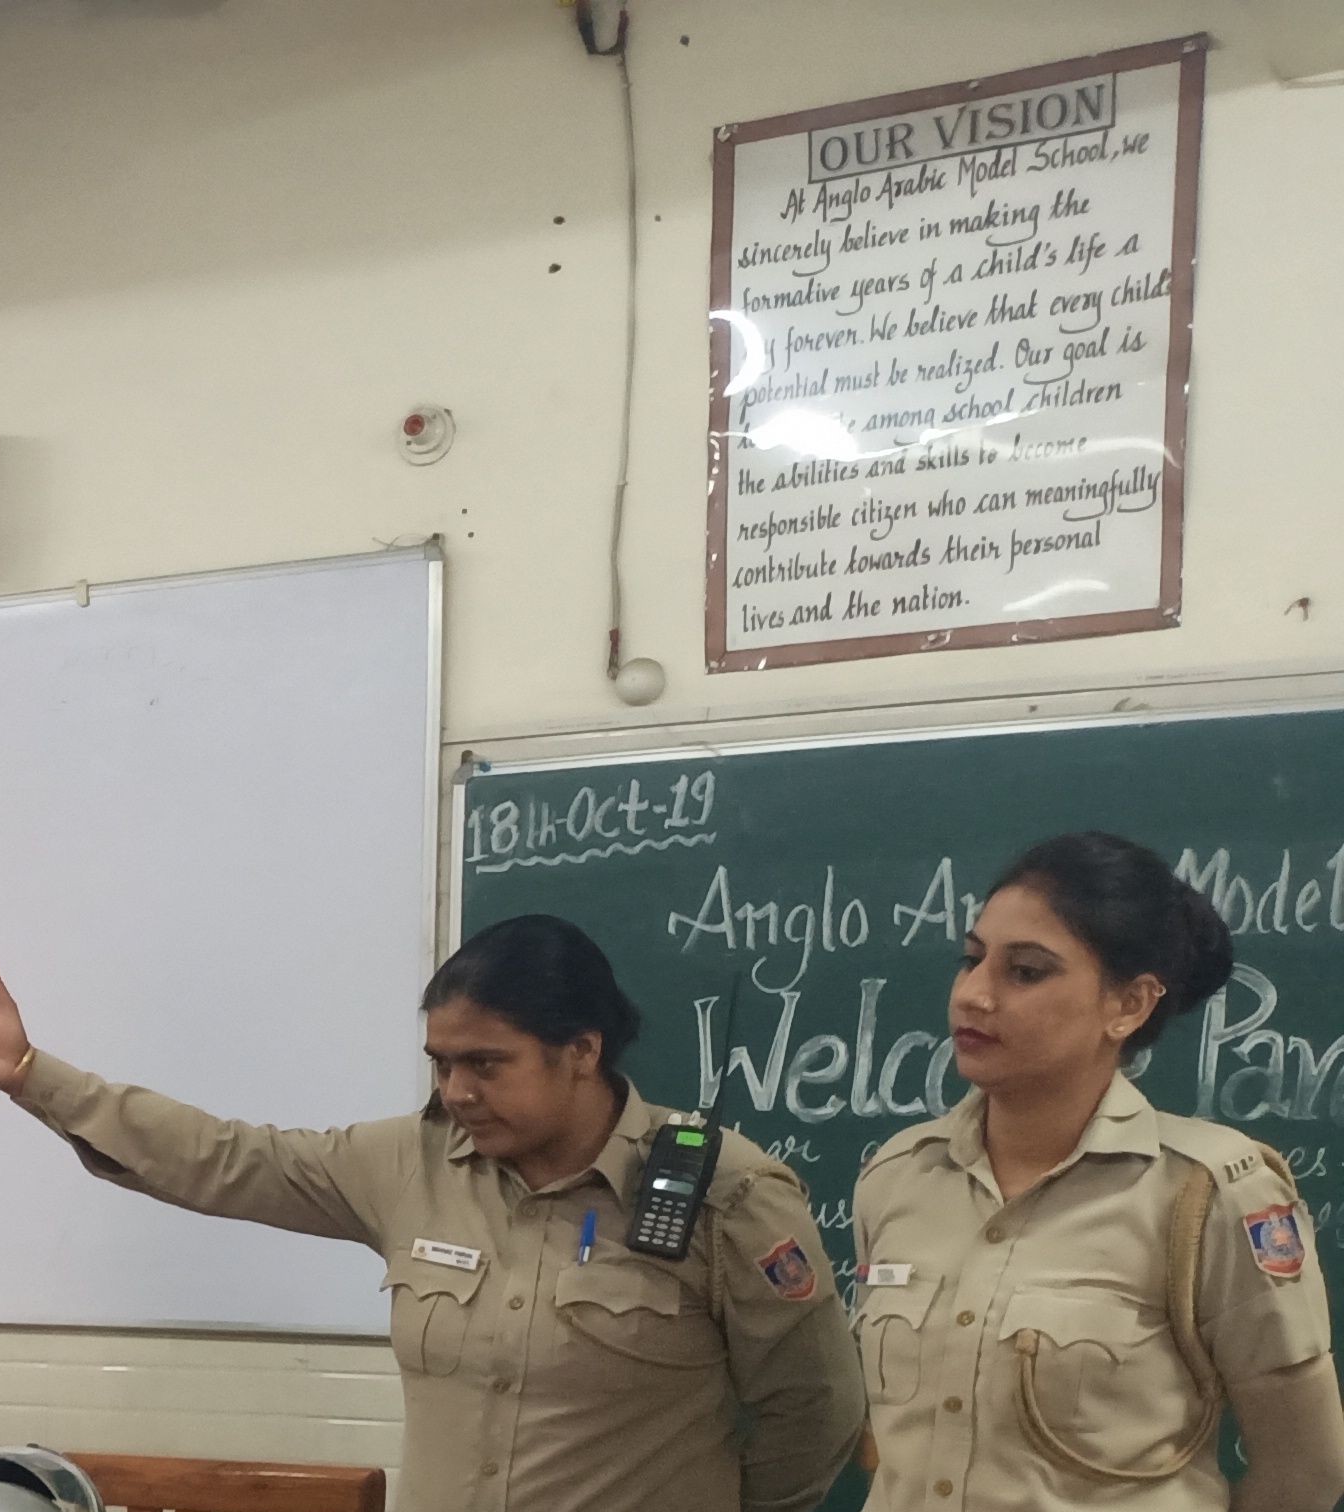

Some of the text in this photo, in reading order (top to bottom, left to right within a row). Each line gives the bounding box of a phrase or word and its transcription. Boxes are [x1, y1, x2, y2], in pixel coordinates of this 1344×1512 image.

[820, 83, 1107, 172] OUR VISION
[780, 129, 1150, 224] At Anglo Arabic Model School, we
[737, 187, 1091, 277] sincerely believe in making the
[740, 232, 1140, 317] formative years of a child's life a
[784, 326, 865, 373] forever.
[869, 311, 898, 343] We
[902, 304, 979, 338] believe
[984, 288, 1038, 327] that
[1049, 290, 1103, 335] every
[739, 368, 829, 425] potential
[834, 360, 880, 394] must
[885, 357, 908, 386] be
[917, 341, 1005, 394] realized.
[1015, 337, 1055, 369] Our
[1116, 325, 1148, 354] is
[861, 406, 935, 447] among
[941, 387, 1015, 423] school
[1020, 378, 1124, 415] children
[737, 433, 1088, 496] the abilities and skills to become
[737, 464, 1162, 553] responsible citizen who can meaningfully
[731, 519, 1102, 589] contribute towards their personal
[741, 582, 971, 634] lives and the nation.
[667, 864, 870, 994] Anglo
[1172, 843, 1344, 936] Model
